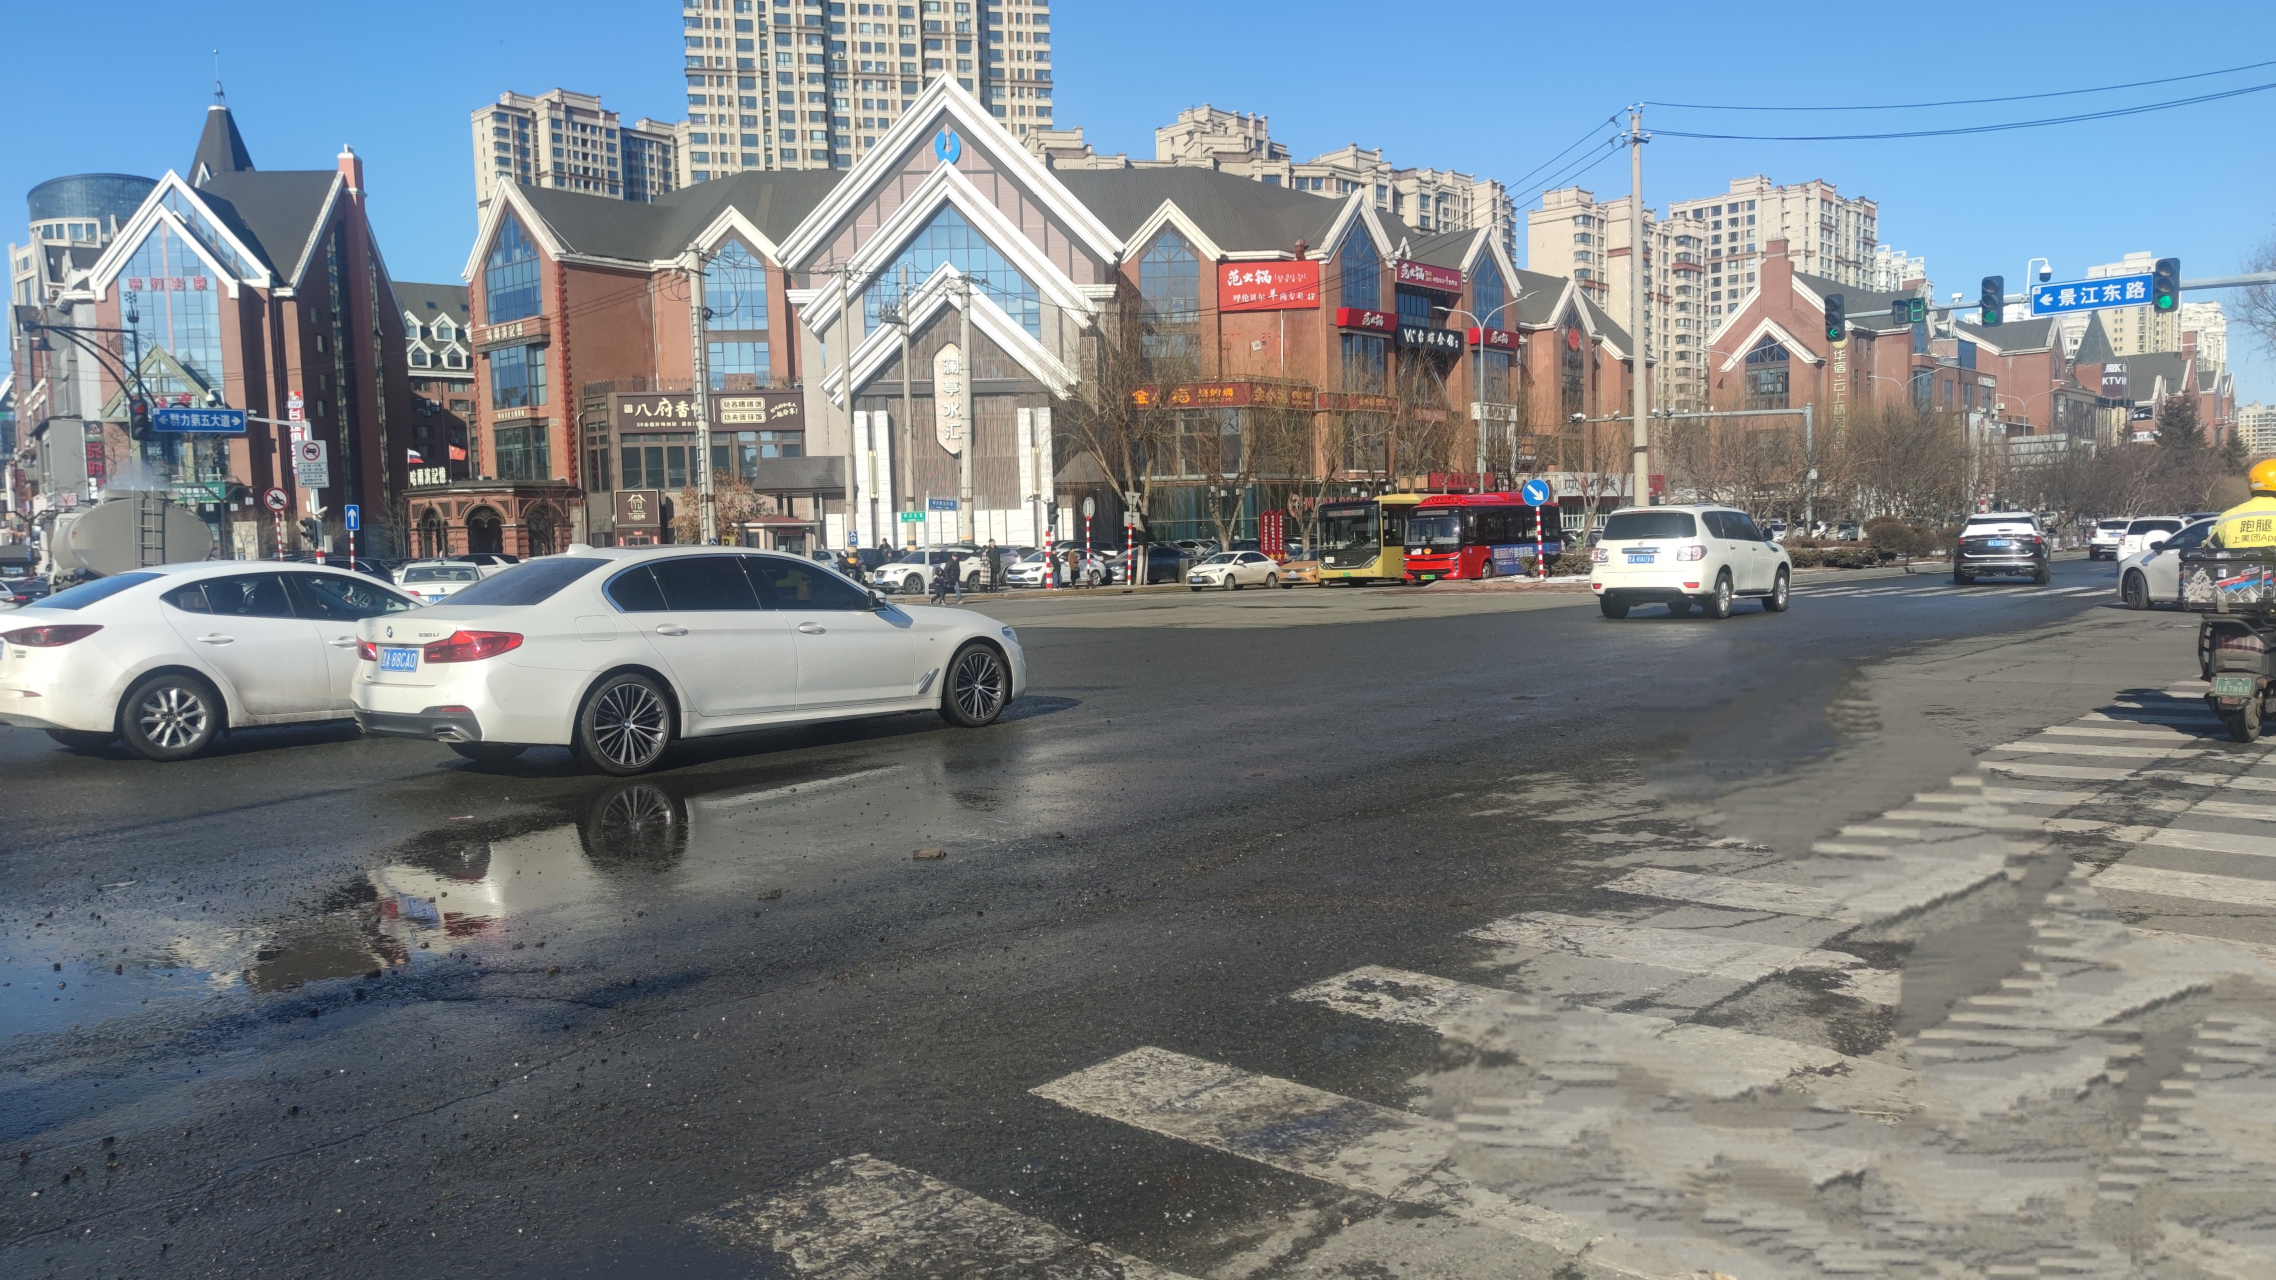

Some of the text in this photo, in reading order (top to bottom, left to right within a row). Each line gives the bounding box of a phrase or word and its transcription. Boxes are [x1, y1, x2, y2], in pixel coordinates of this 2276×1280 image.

[1227, 268, 1272, 287] 范火锅
[1400, 263, 1425, 281] 范火锅
[2058, 281, 2146, 307] 景江东路
[1362, 311, 1384, 328] 范火锅
[1490, 330, 1509, 344] 范火锅
[2102, 376, 2121, 386] KTV
[942, 359, 962, 440] 澜亭水汇
[169, 413, 231, 428] 群力第五大道
[723, 413, 763, 421] 功夫煲仔饭
[2240, 519, 2273, 533] 跑腿
